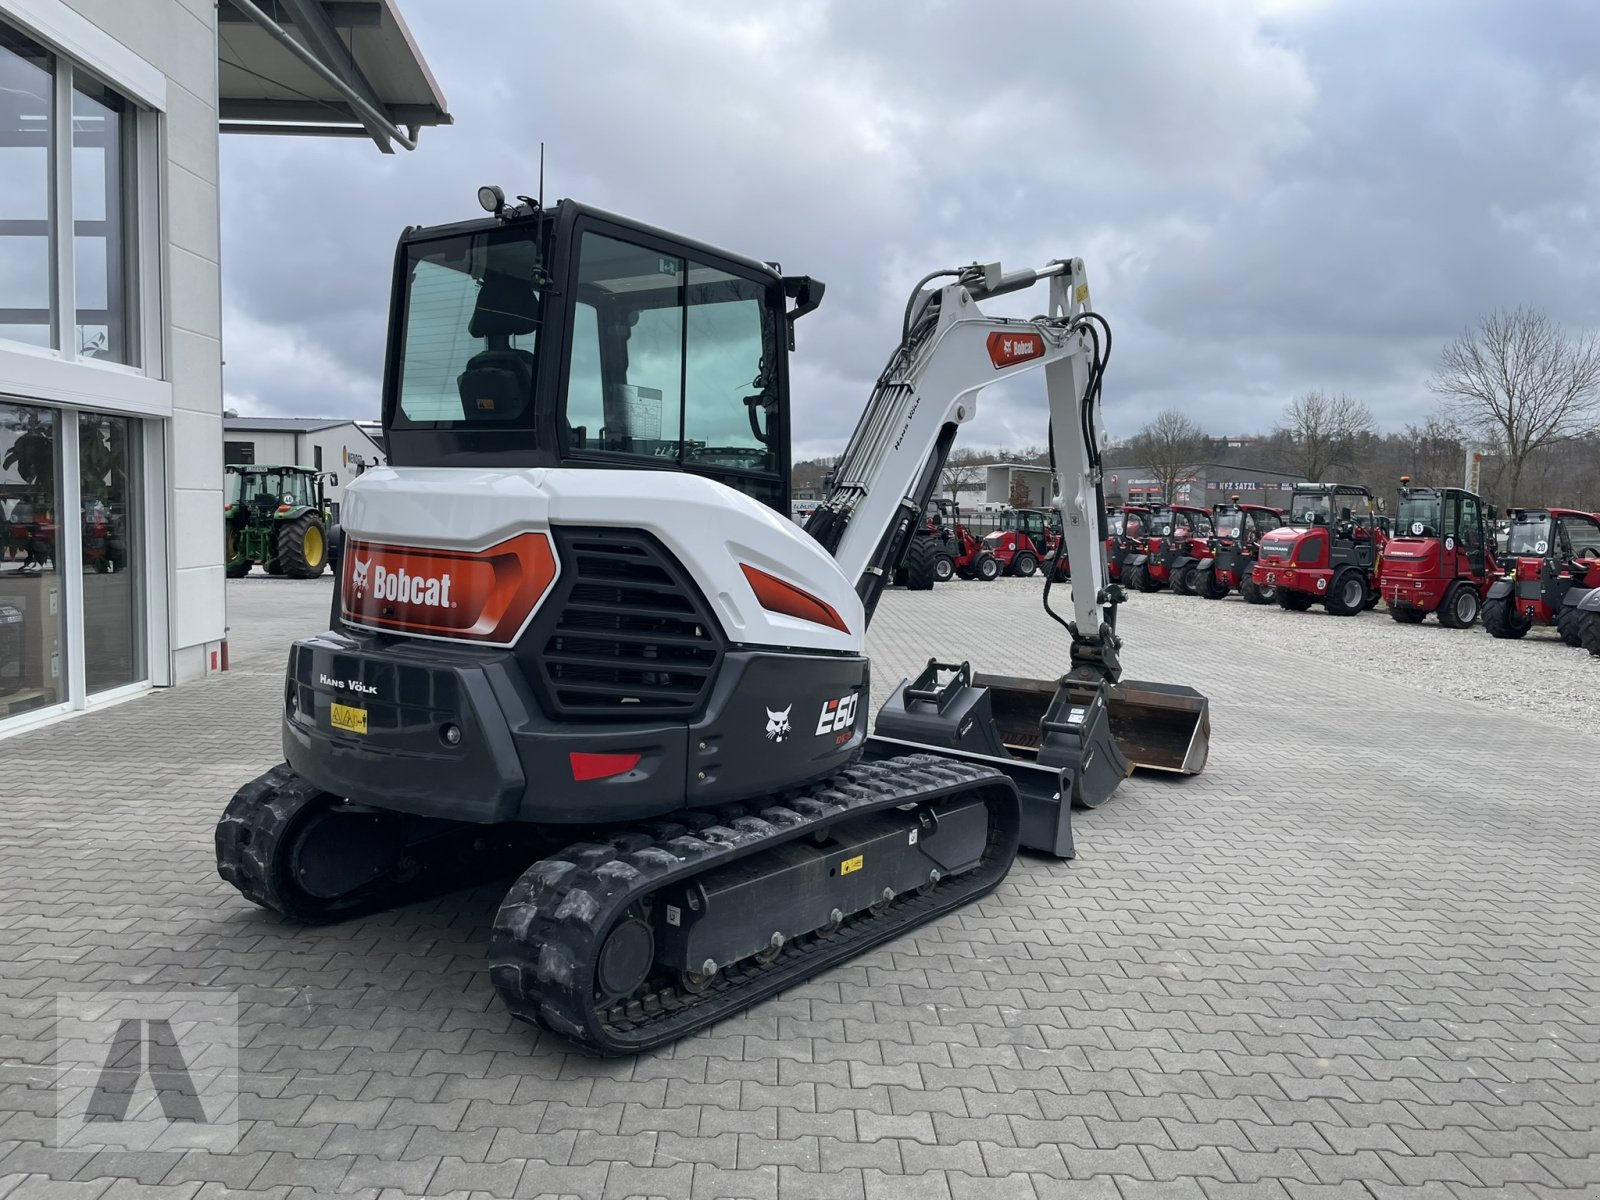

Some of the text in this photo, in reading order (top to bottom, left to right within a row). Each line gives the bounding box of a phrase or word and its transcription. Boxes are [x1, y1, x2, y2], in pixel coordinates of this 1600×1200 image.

[1013, 340, 1034, 356] Bobcat
[1414, 524, 1421, 533] 15
[1537, 543, 1545, 551] 20
[373, 565, 451, 608] Bobcat
[320, 673, 378, 695] HANS VÖLK
[815, 692, 858, 736] E60
